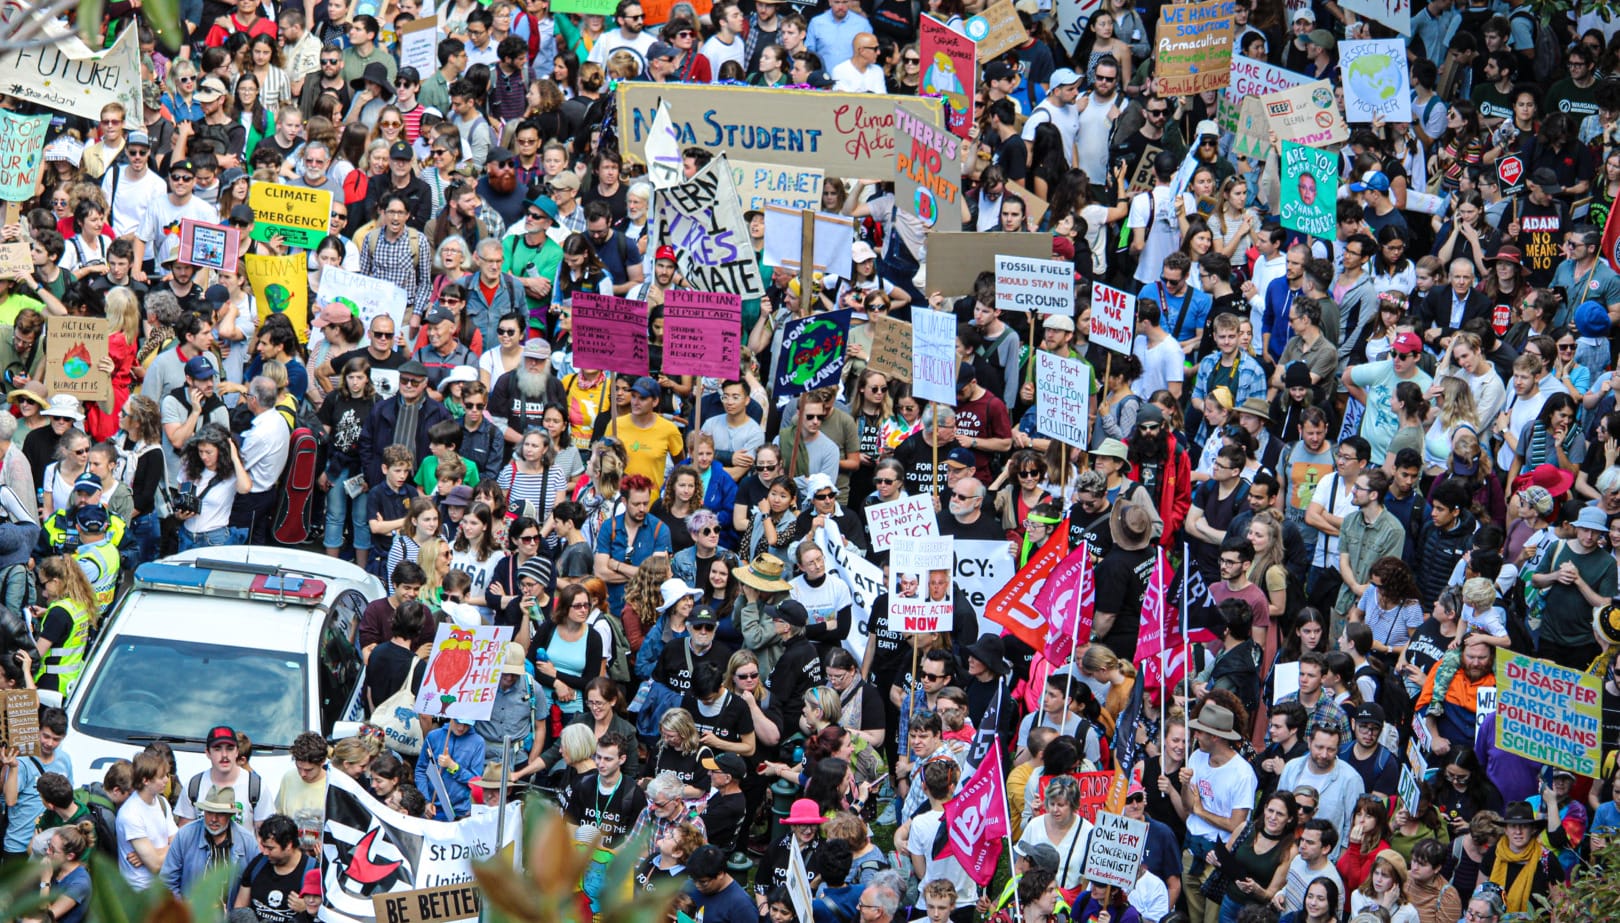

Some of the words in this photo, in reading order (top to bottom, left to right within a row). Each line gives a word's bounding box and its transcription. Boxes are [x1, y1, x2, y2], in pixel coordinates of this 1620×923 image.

[1163, 7, 1184, 25] WE
[1189, 3, 1220, 22] HAVE
[1158, 34, 1227, 53] Permaculture
[1202, 71, 1232, 89] CHANGE
[1269, 103, 1290, 116] KEEP
[1352, 97, 1401, 114] MOTHER
[3, 117, 42, 136] STOP
[703, 110, 822, 154] STUDENT
[895, 107, 958, 161] THERE'S
[911, 138, 942, 174] NO
[1286, 146, 1308, 165] ARE
[1314, 150, 1337, 176] YOU
[753, 167, 822, 194] PLANET
[897, 152, 959, 205] PLANET
[1287, 161, 1329, 184] SMARTER
[264, 187, 318, 204] CLIMATE
[919, 191, 933, 220] B
[252, 208, 328, 229] EMERGENCY
[1522, 216, 1560, 231] ADANI
[1531, 231, 1552, 246] NO
[1525, 242, 1558, 258] MEANS
[1000, 261, 1036, 273] FOSSIL
[1040, 264, 1071, 276] FUELS
[1532, 254, 1552, 270] NO
[996, 276, 1030, 287] SHOULD
[1031, 279, 1055, 290] STAY
[1057, 281, 1069, 292] IN
[996, 291, 1013, 302] THE
[1014, 293, 1069, 308] GROUND
[1094, 284, 1127, 309] SAVE
[1103, 305, 1122, 321] OUR
[61, 322, 77, 332] ACT
[78, 321, 98, 332] LIKE
[782, 315, 817, 350] DON'T
[913, 311, 956, 340] CLIMATE
[803, 355, 844, 392] PLANET
[912, 353, 955, 388] EMERGENCY
[1041, 354, 1054, 370] Be
[1060, 359, 1080, 377] Part
[1046, 371, 1056, 383] of
[1060, 374, 1074, 390] the
[1038, 379, 1084, 404] SOLUTION
[1042, 392, 1058, 405] Not
[1061, 397, 1082, 415] Part
[1046, 408, 1057, 421] of
[1060, 411, 1077, 427] the
[1039, 415, 1086, 446] POLLUTION
[915, 462, 932, 472] FOR
[870, 499, 927, 521] DENIAL
[879, 520, 890, 531] IS
[894, 514, 913, 527] NOT
[916, 513, 926, 524] A
[891, 603, 926, 617] CLIMATE
[493, 627, 500, 640] I
[904, 617, 939, 632] NOW
[472, 639, 510, 653] SPEAK
[877, 639, 898, 650] EARTH
[1506, 662, 1598, 705] DISASTER
[1512, 679, 1570, 709] MOVIE
[457, 686, 497, 704] TREES
[1500, 690, 1556, 720] STARTS
[1562, 709, 1598, 732] WITH
[1497, 702, 1597, 749] POLITICIANS
[385, 727, 419, 748] BRONX
[1502, 717, 1586, 757] IGNORING
[1502, 732, 1595, 776] SCIENTISTS
[1102, 814, 1106, 826] I
[1111, 817, 1129, 832] AM
[1095, 827, 1116, 842] ONE
[1118, 832, 1140, 849] VERY
[429, 843, 447, 862] St
[451, 839, 491, 862] Davids
[1092, 841, 1138, 864] CONCERNED
[1089, 855, 1135, 875] SCIENTIST!
[386, 896, 410, 923] BE
